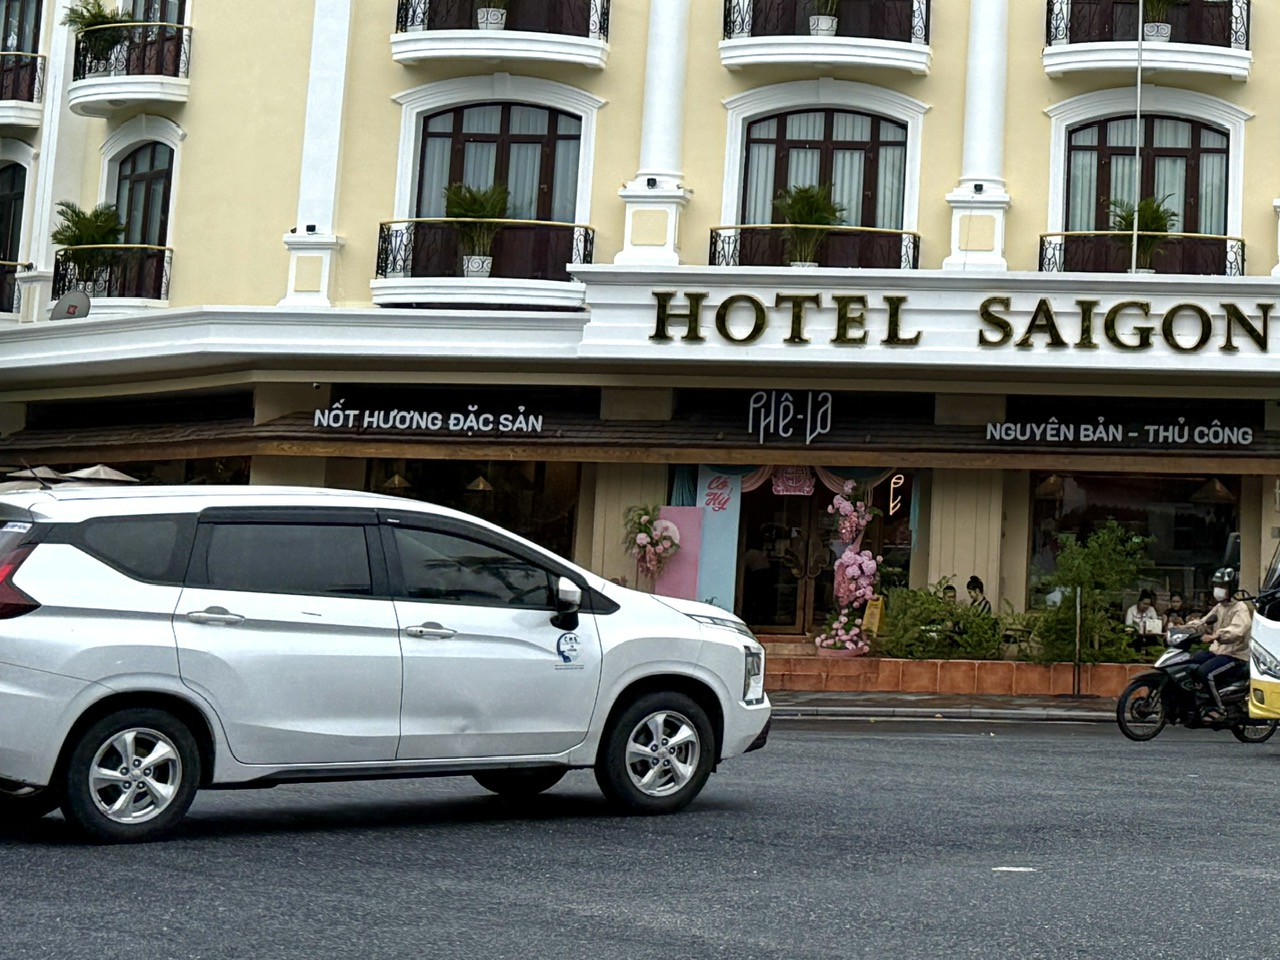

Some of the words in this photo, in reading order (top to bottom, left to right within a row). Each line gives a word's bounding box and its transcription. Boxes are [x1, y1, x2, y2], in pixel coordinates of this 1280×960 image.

[648, 289, 923, 346] HOTEL
[978, 296, 1276, 352] SAIGON
[314, 398, 360, 428] NỐT
[363, 408, 443, 430] HƯƠNG
[448, 404, 494, 436] ĐẶC
[498, 406, 543, 432] SẢN
[986, 416, 1074, 442] NGUYÊN
[1080, 416, 1123, 442] BẢN
[1144, 416, 1189, 444] THỦ
[1194, 419, 1254, 445] CÔNG
